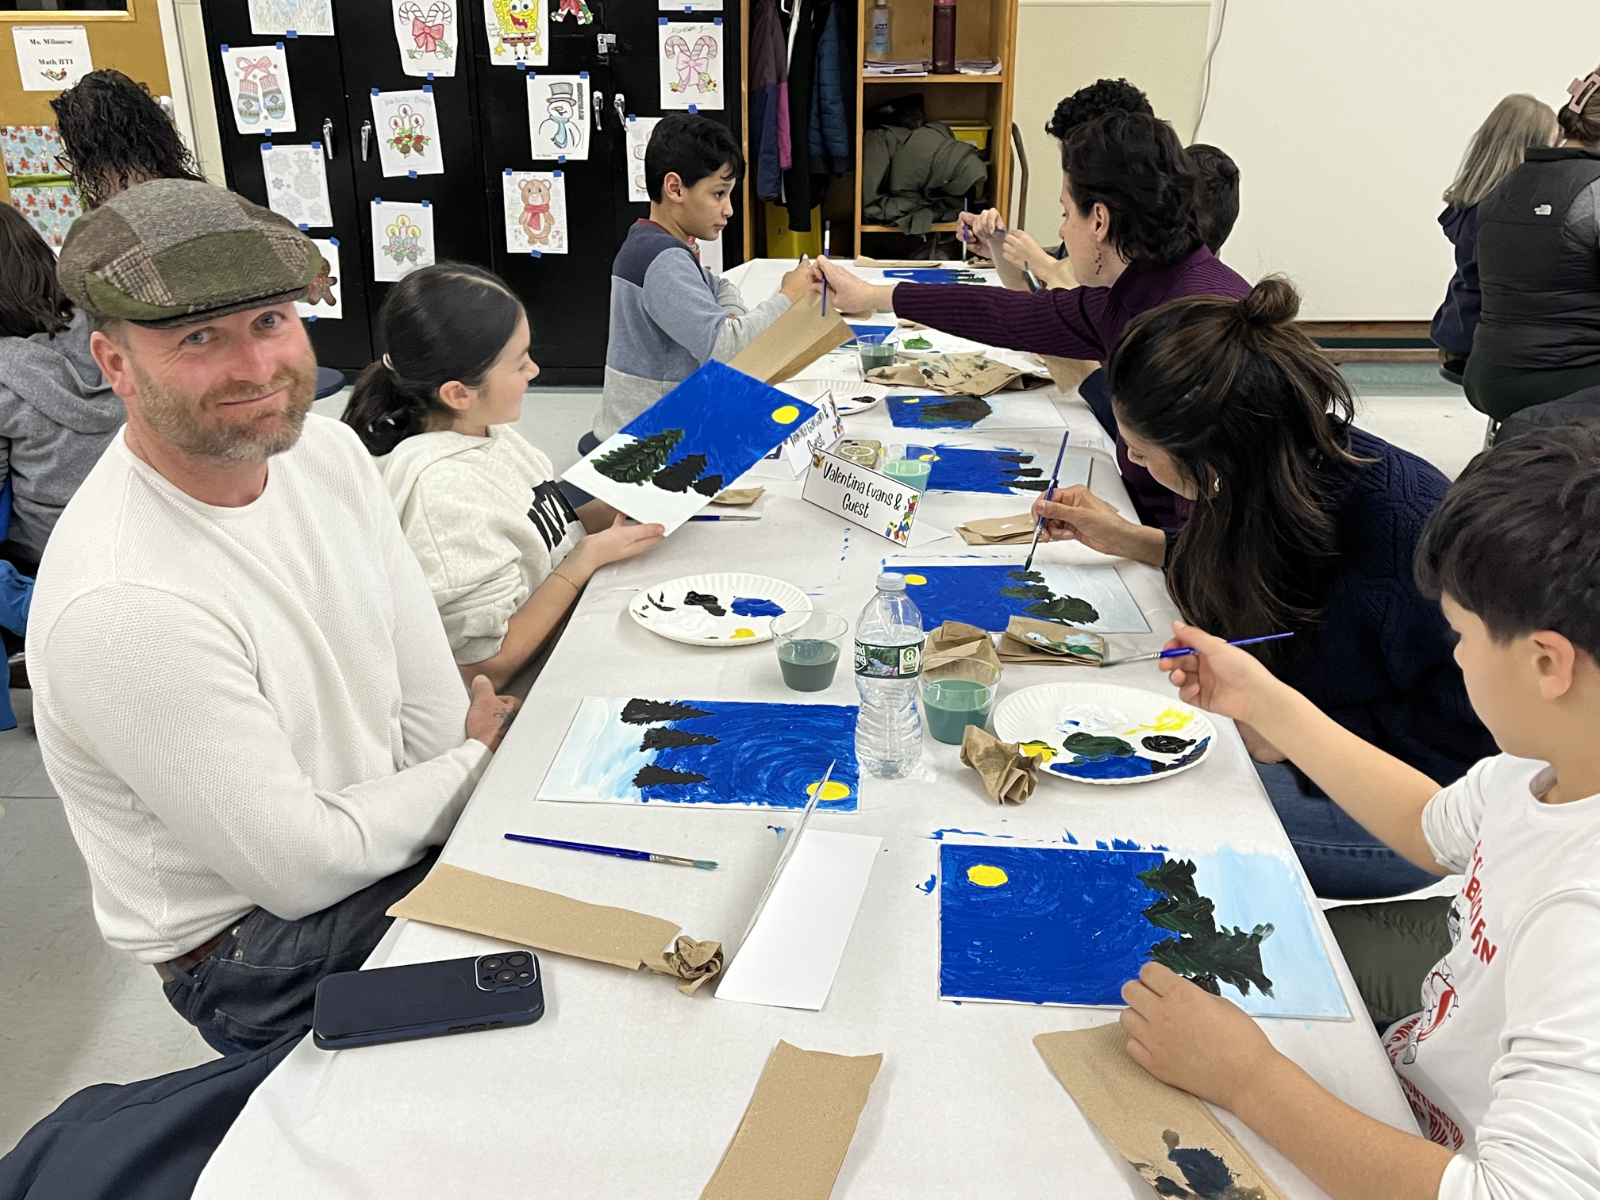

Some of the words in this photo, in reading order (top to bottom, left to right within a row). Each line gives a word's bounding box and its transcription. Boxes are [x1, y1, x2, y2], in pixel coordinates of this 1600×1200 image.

[822, 461, 865, 494] Valentina
[865, 482, 894, 506] Evans
[894, 493, 903, 510] &
[842, 493, 869, 519] Guest
